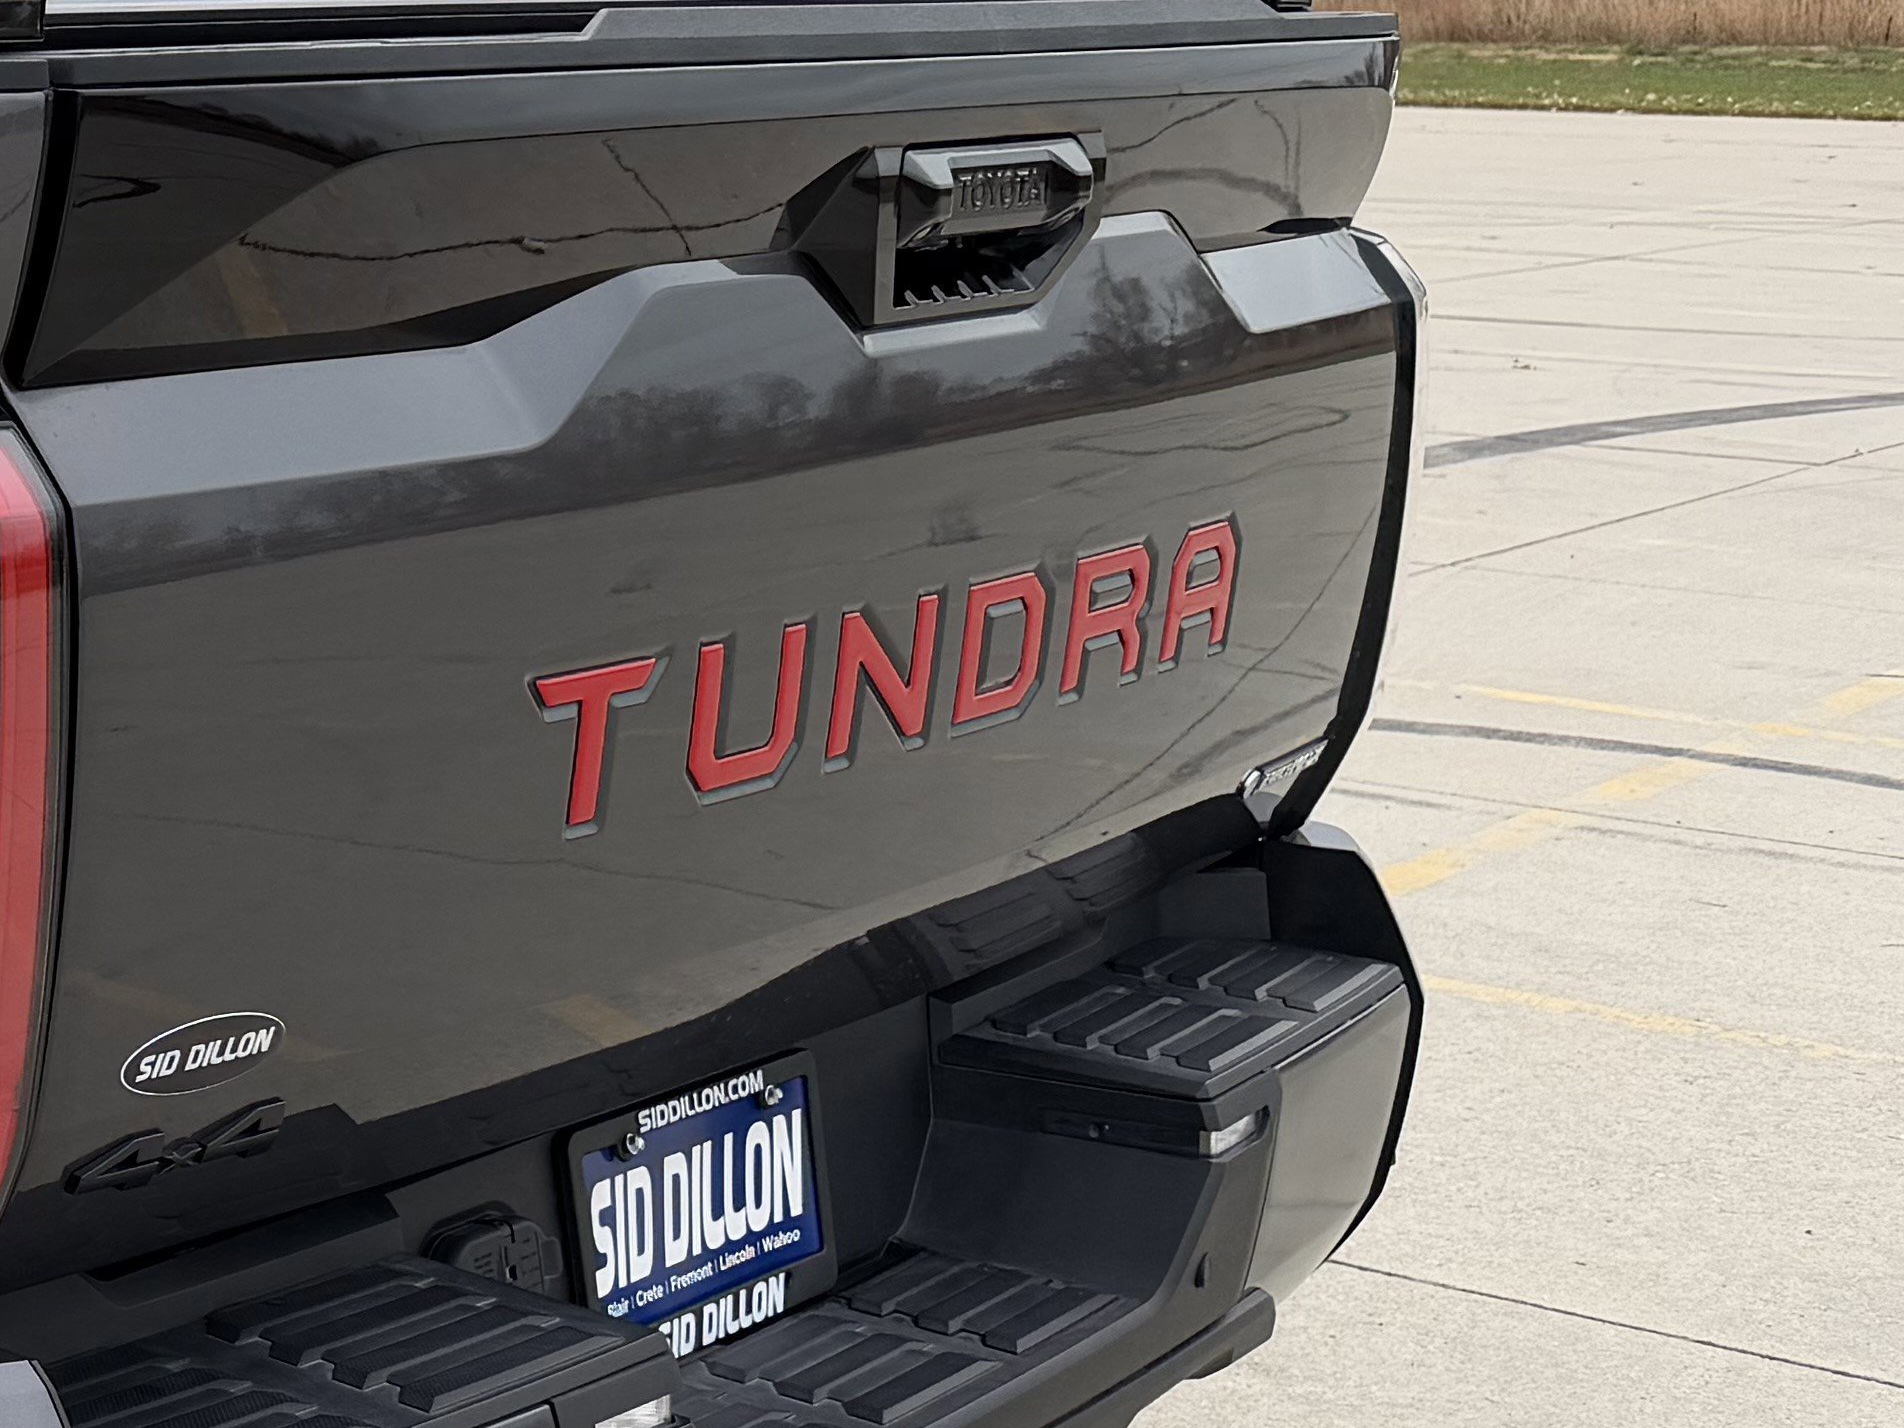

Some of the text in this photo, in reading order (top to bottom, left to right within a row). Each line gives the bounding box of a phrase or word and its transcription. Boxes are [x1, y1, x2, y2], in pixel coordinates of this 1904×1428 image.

[958, 166, 1046, 213] TOYOTA
[526, 510, 1245, 840] TUNDRA
[135, 1026, 276, 1083] SID DILLON
[638, 1069, 765, 1134] SIDDILLON.COM
[590, 1165, 654, 1299] SID
[663, 1108, 804, 1268] DILLON
[635, 1284, 664, 1307] Crete
[669, 1261, 713, 1292] Fremont
[719, 1243, 756, 1271] Lincoln
[762, 1228, 801, 1253] Wahoo
[702, 1272, 786, 1346] DILLON
